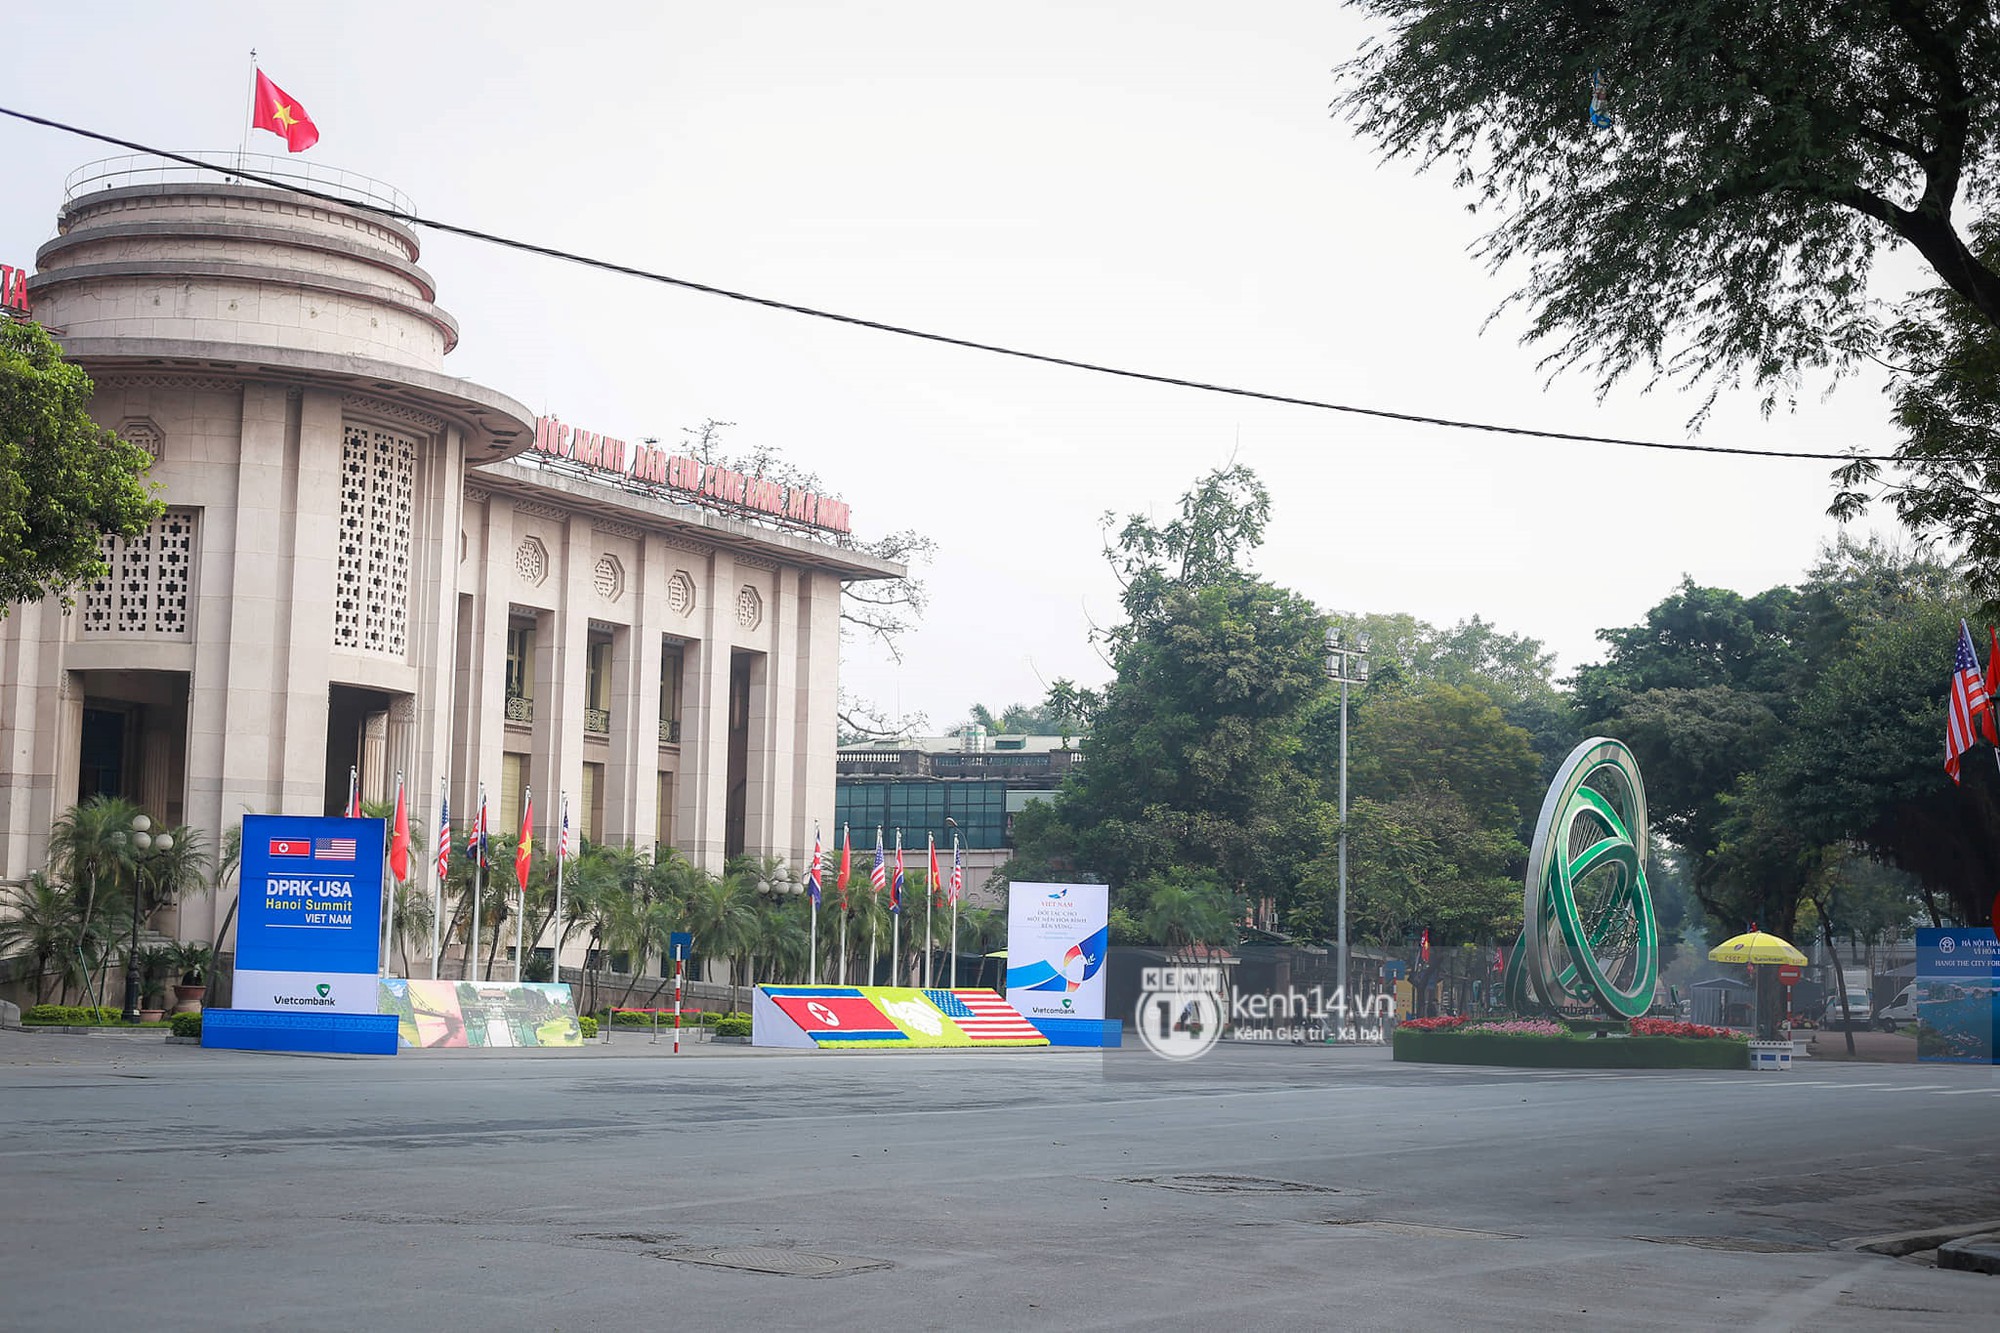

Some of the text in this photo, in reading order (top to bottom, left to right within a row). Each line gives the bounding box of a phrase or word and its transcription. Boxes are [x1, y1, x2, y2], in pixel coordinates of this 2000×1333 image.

[0, 264, 28, 310] TA
[535, 413, 569, 456] ƯỚC
[635, 443, 666, 484] DÂN
[266, 879, 352, 897] DPRK-USA
[265, 898, 352, 911] Hanoi Summit
[305, 913, 352, 925] VIET NAM
[274, 995, 336, 1007] Vietcombank
